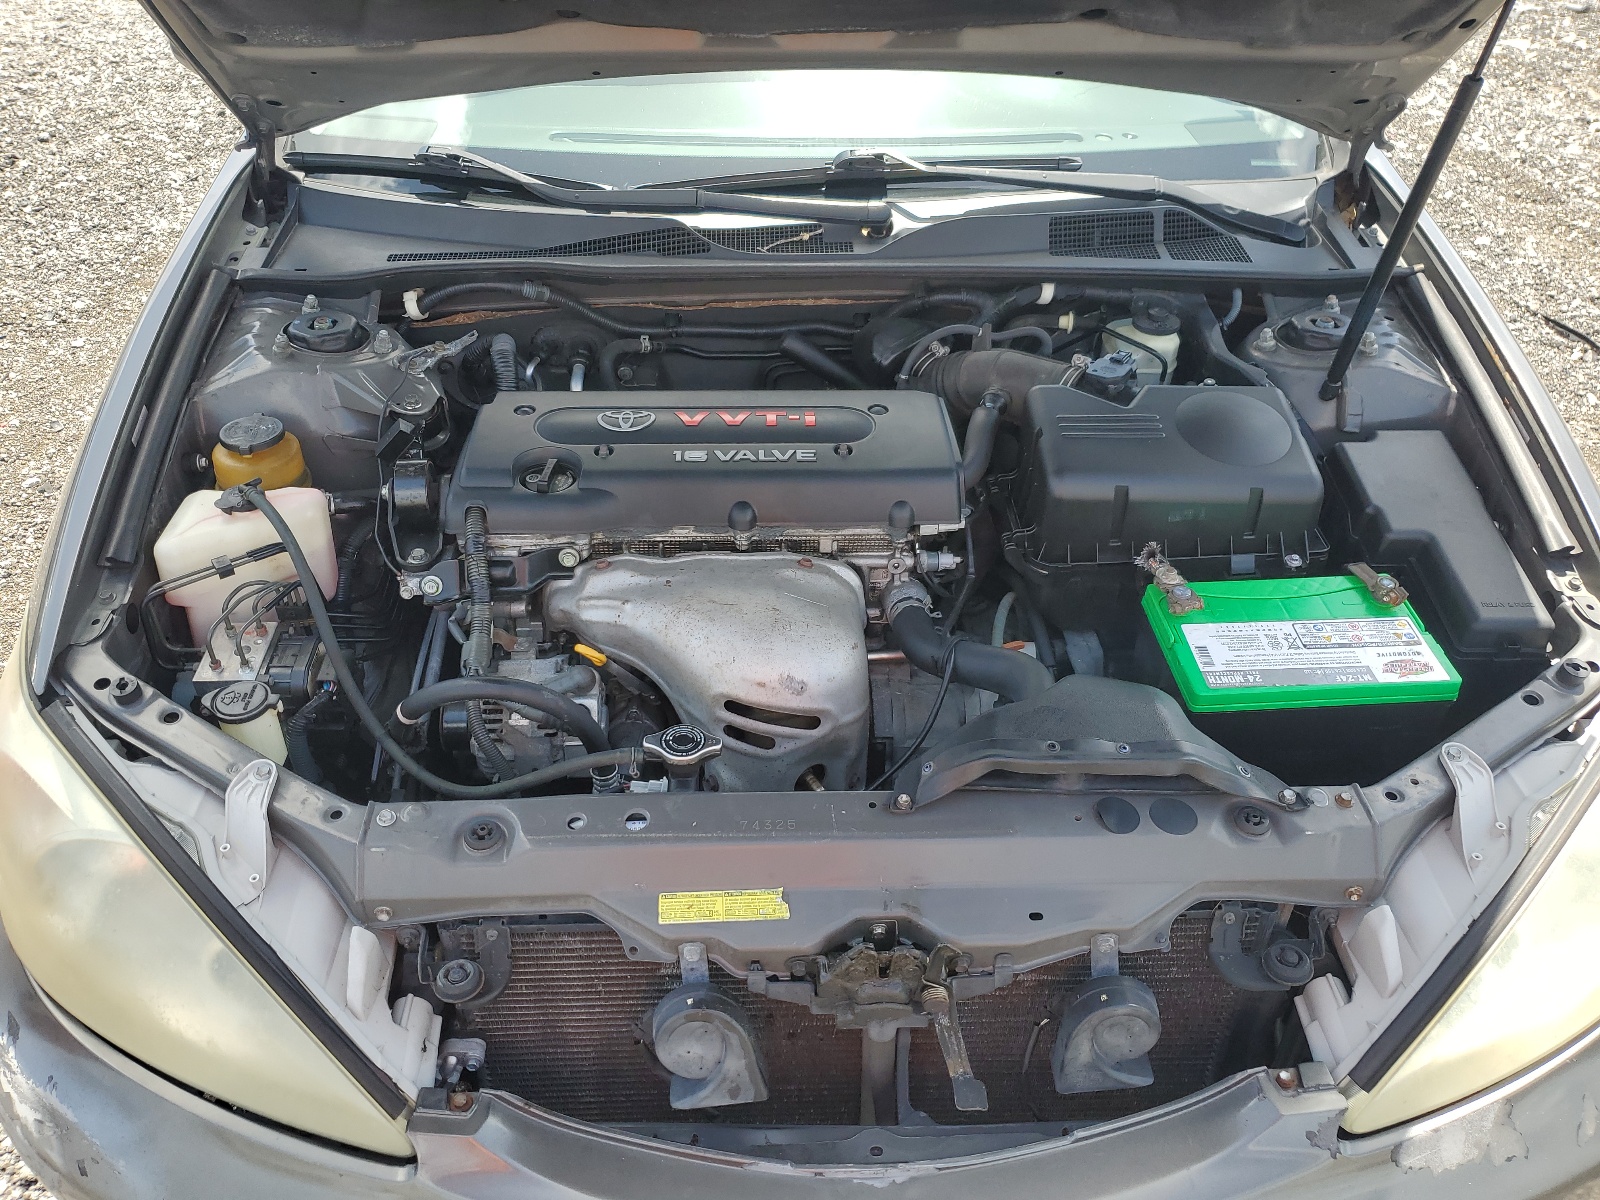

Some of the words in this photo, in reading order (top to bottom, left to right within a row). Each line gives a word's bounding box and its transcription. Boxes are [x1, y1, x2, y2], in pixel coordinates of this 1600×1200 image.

[674, 411, 817, 426] VVT-i
[672, 450, 708, 462] 16
[713, 450, 817, 462] VALVE
[1382, 665, 1434, 673] INTERSTATE
[1207, 674, 1263, 684] 24-MONTH
[1335, 673, 1373, 682] MT-24F
[739, 819, 797, 831] 74325
